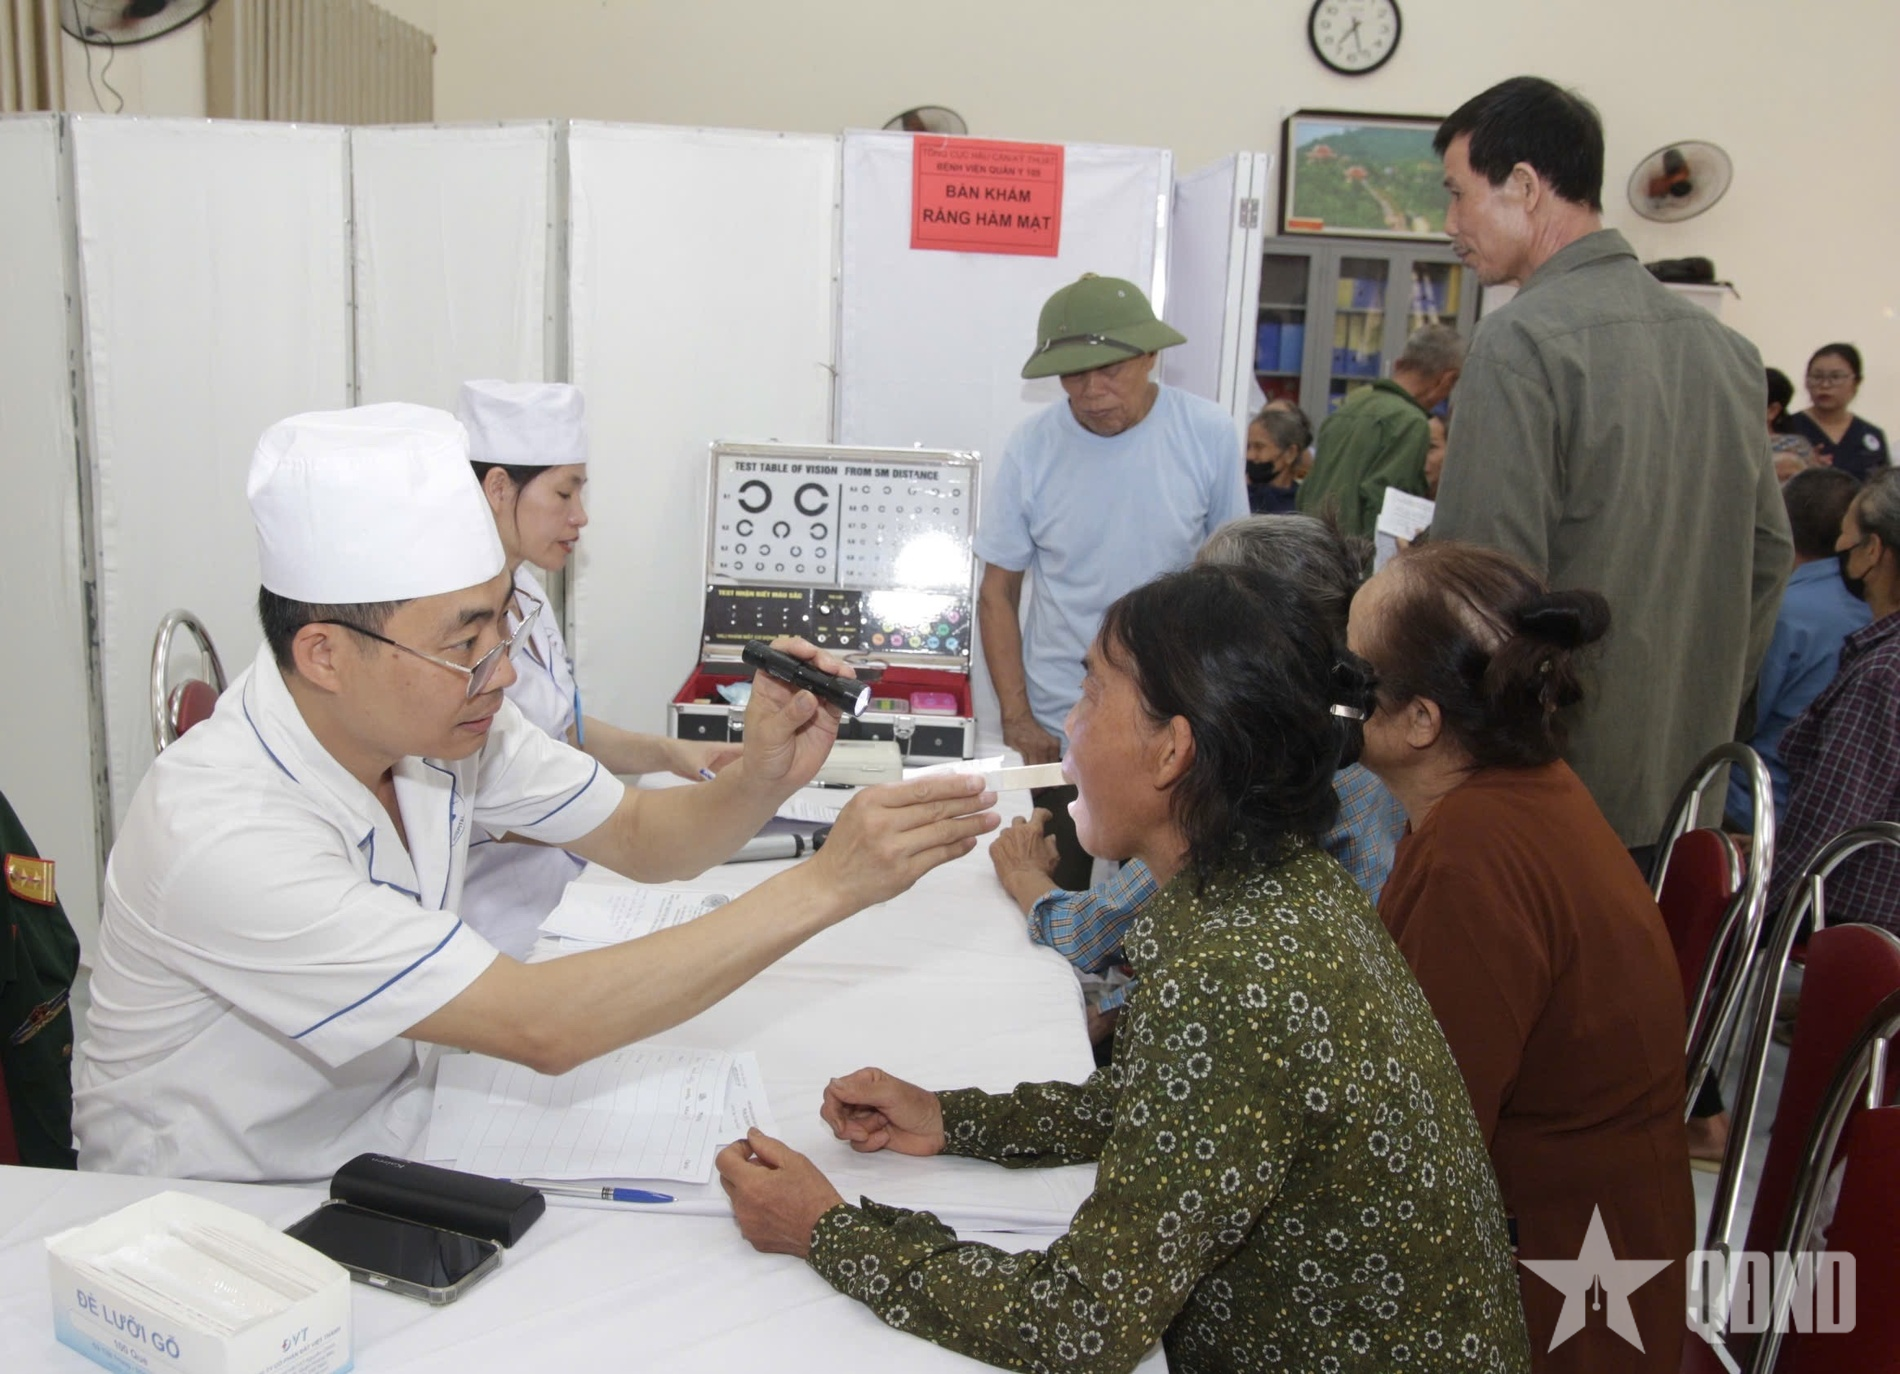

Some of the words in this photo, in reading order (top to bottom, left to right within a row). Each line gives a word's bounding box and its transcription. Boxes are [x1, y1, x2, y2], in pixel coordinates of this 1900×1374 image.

[985, 186, 1031, 202] KHÁM
[976, 210, 1013, 228] HÀM
[735, 462, 757, 471] TEST
[760, 463, 788, 473] TABLE
[791, 464, 804, 473] OF
[806, 465, 838, 475] VISION
[845, 467, 872, 476] FROM
[875, 468, 889, 477] 5M
[892, 469, 939, 480] DISTANCE
[103, 1305, 147, 1343] LƯỠI
[152, 1332, 180, 1359] GỖ
